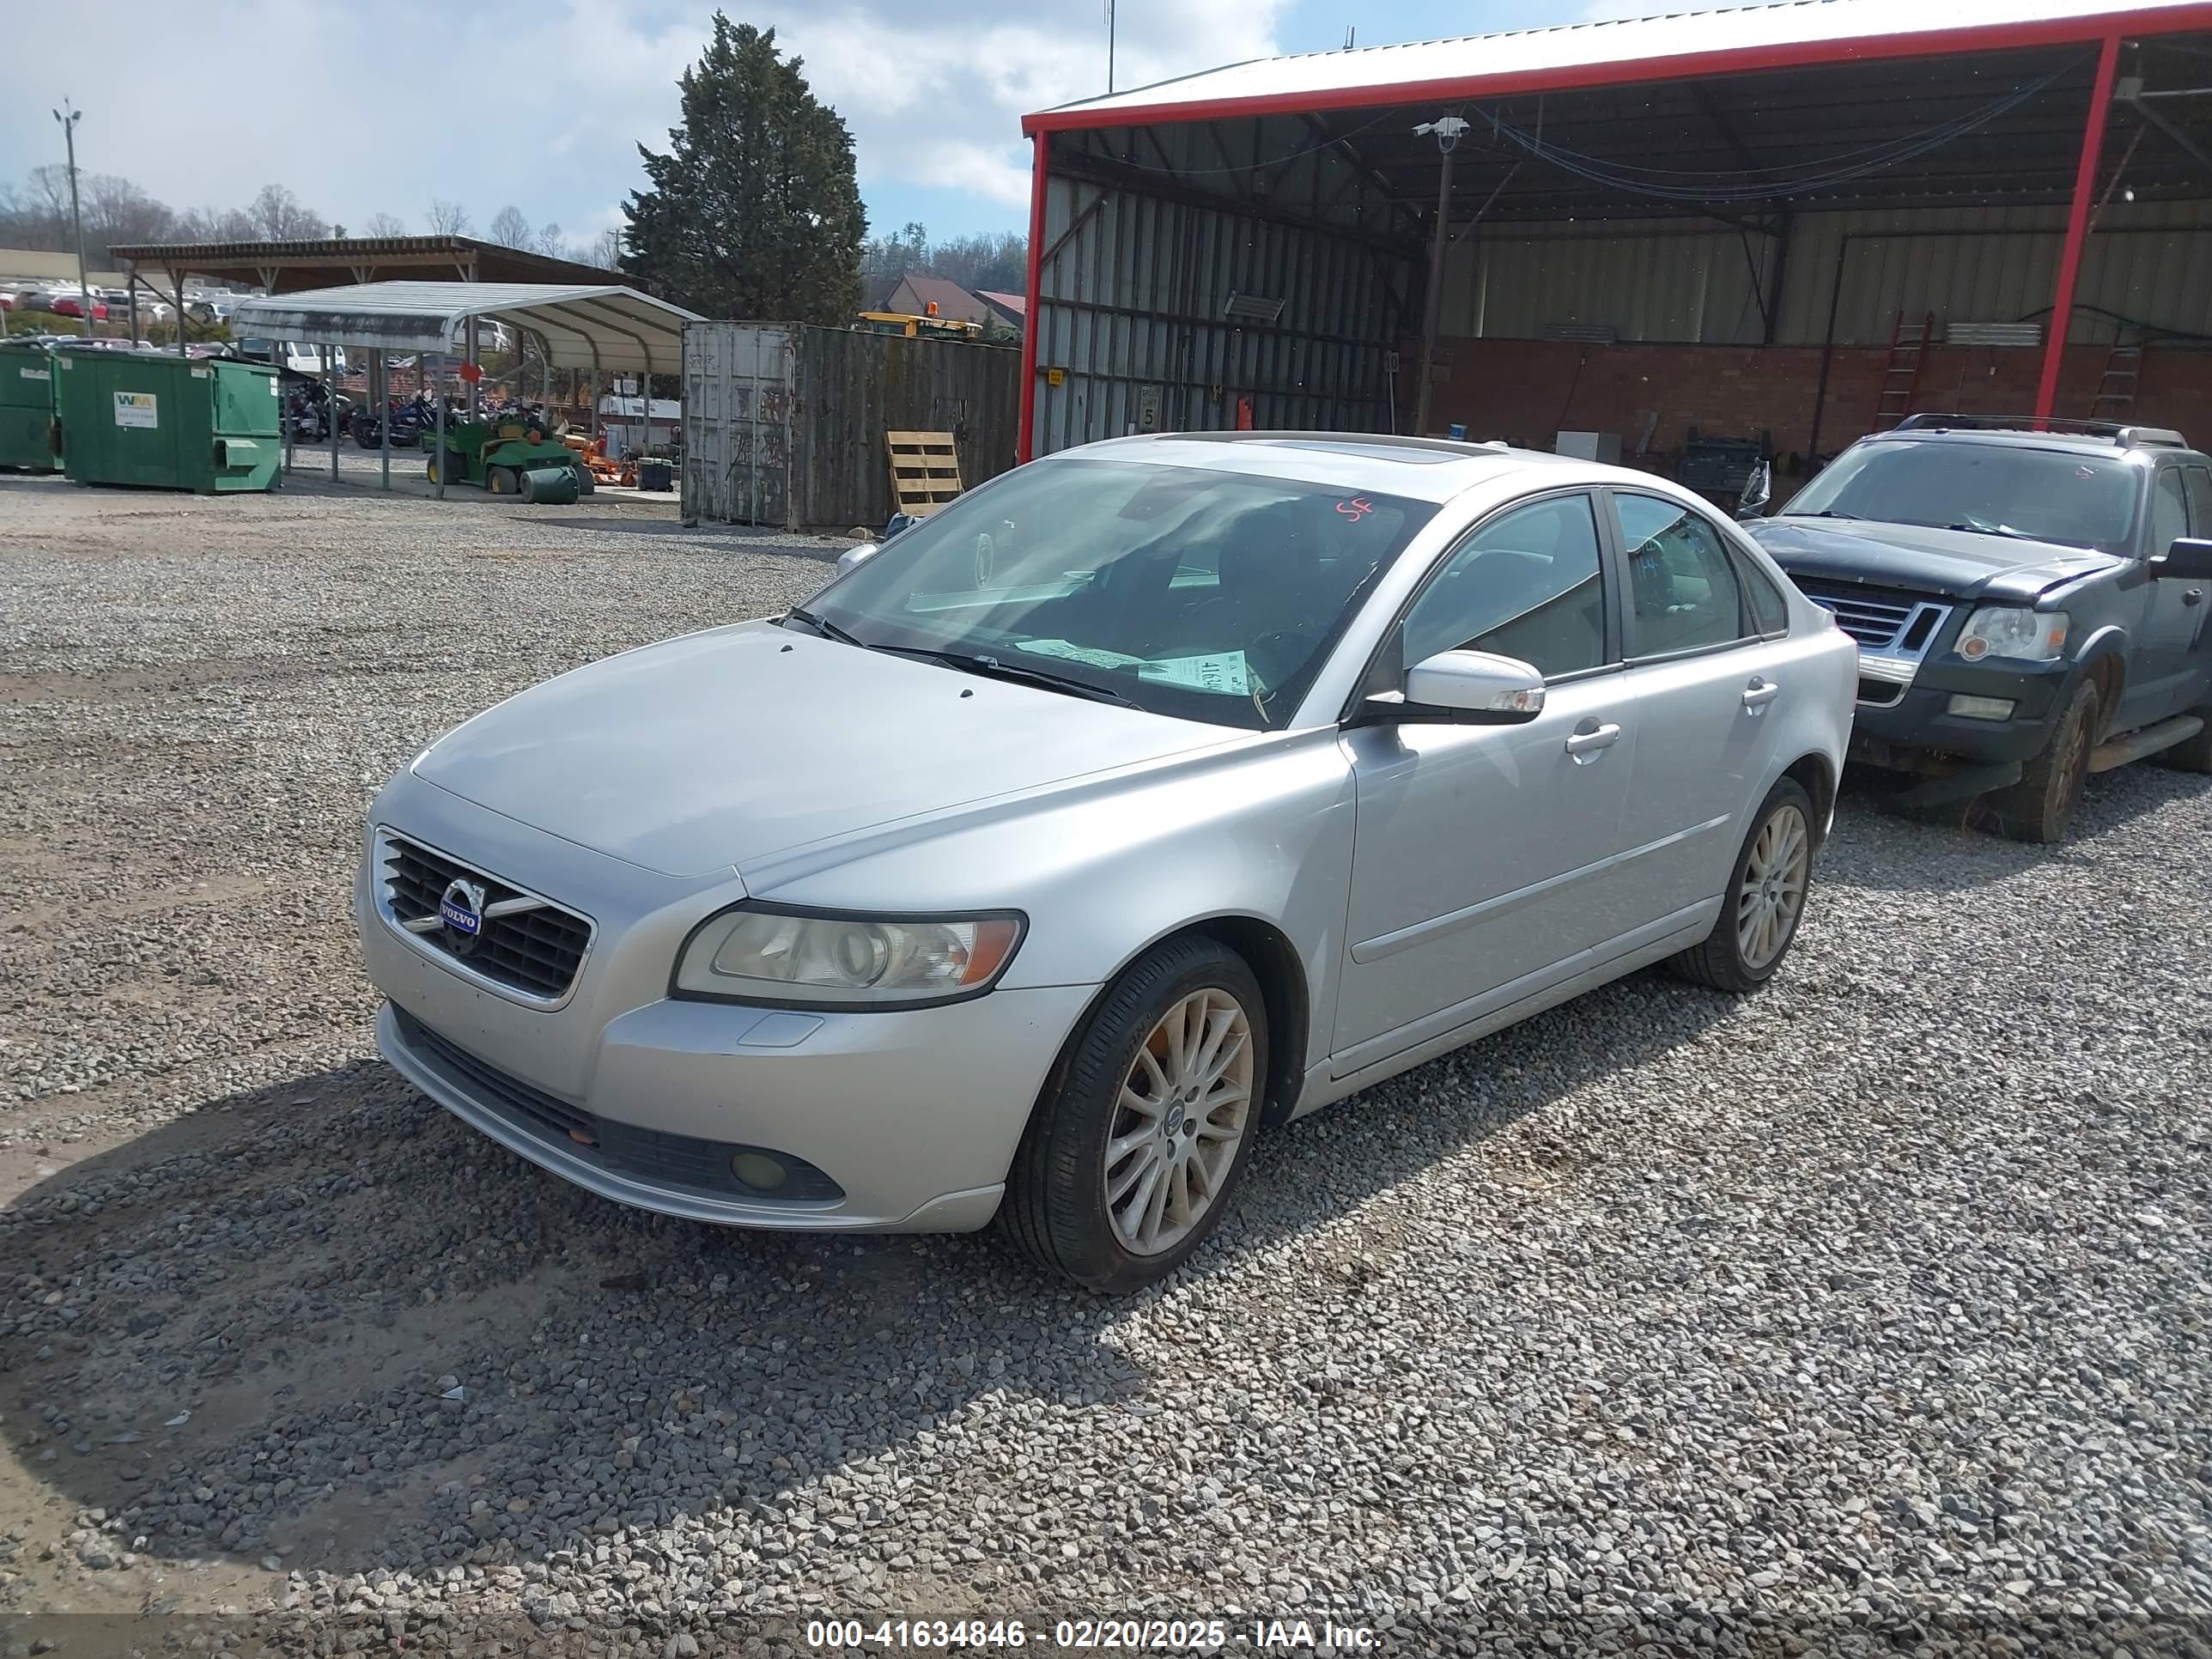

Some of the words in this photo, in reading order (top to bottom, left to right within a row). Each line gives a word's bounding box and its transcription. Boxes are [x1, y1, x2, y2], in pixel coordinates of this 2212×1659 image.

[118, 395, 152, 407] WM
[1145, 409, 1153, 425] 5
[441, 904, 476, 927] VOLVO
